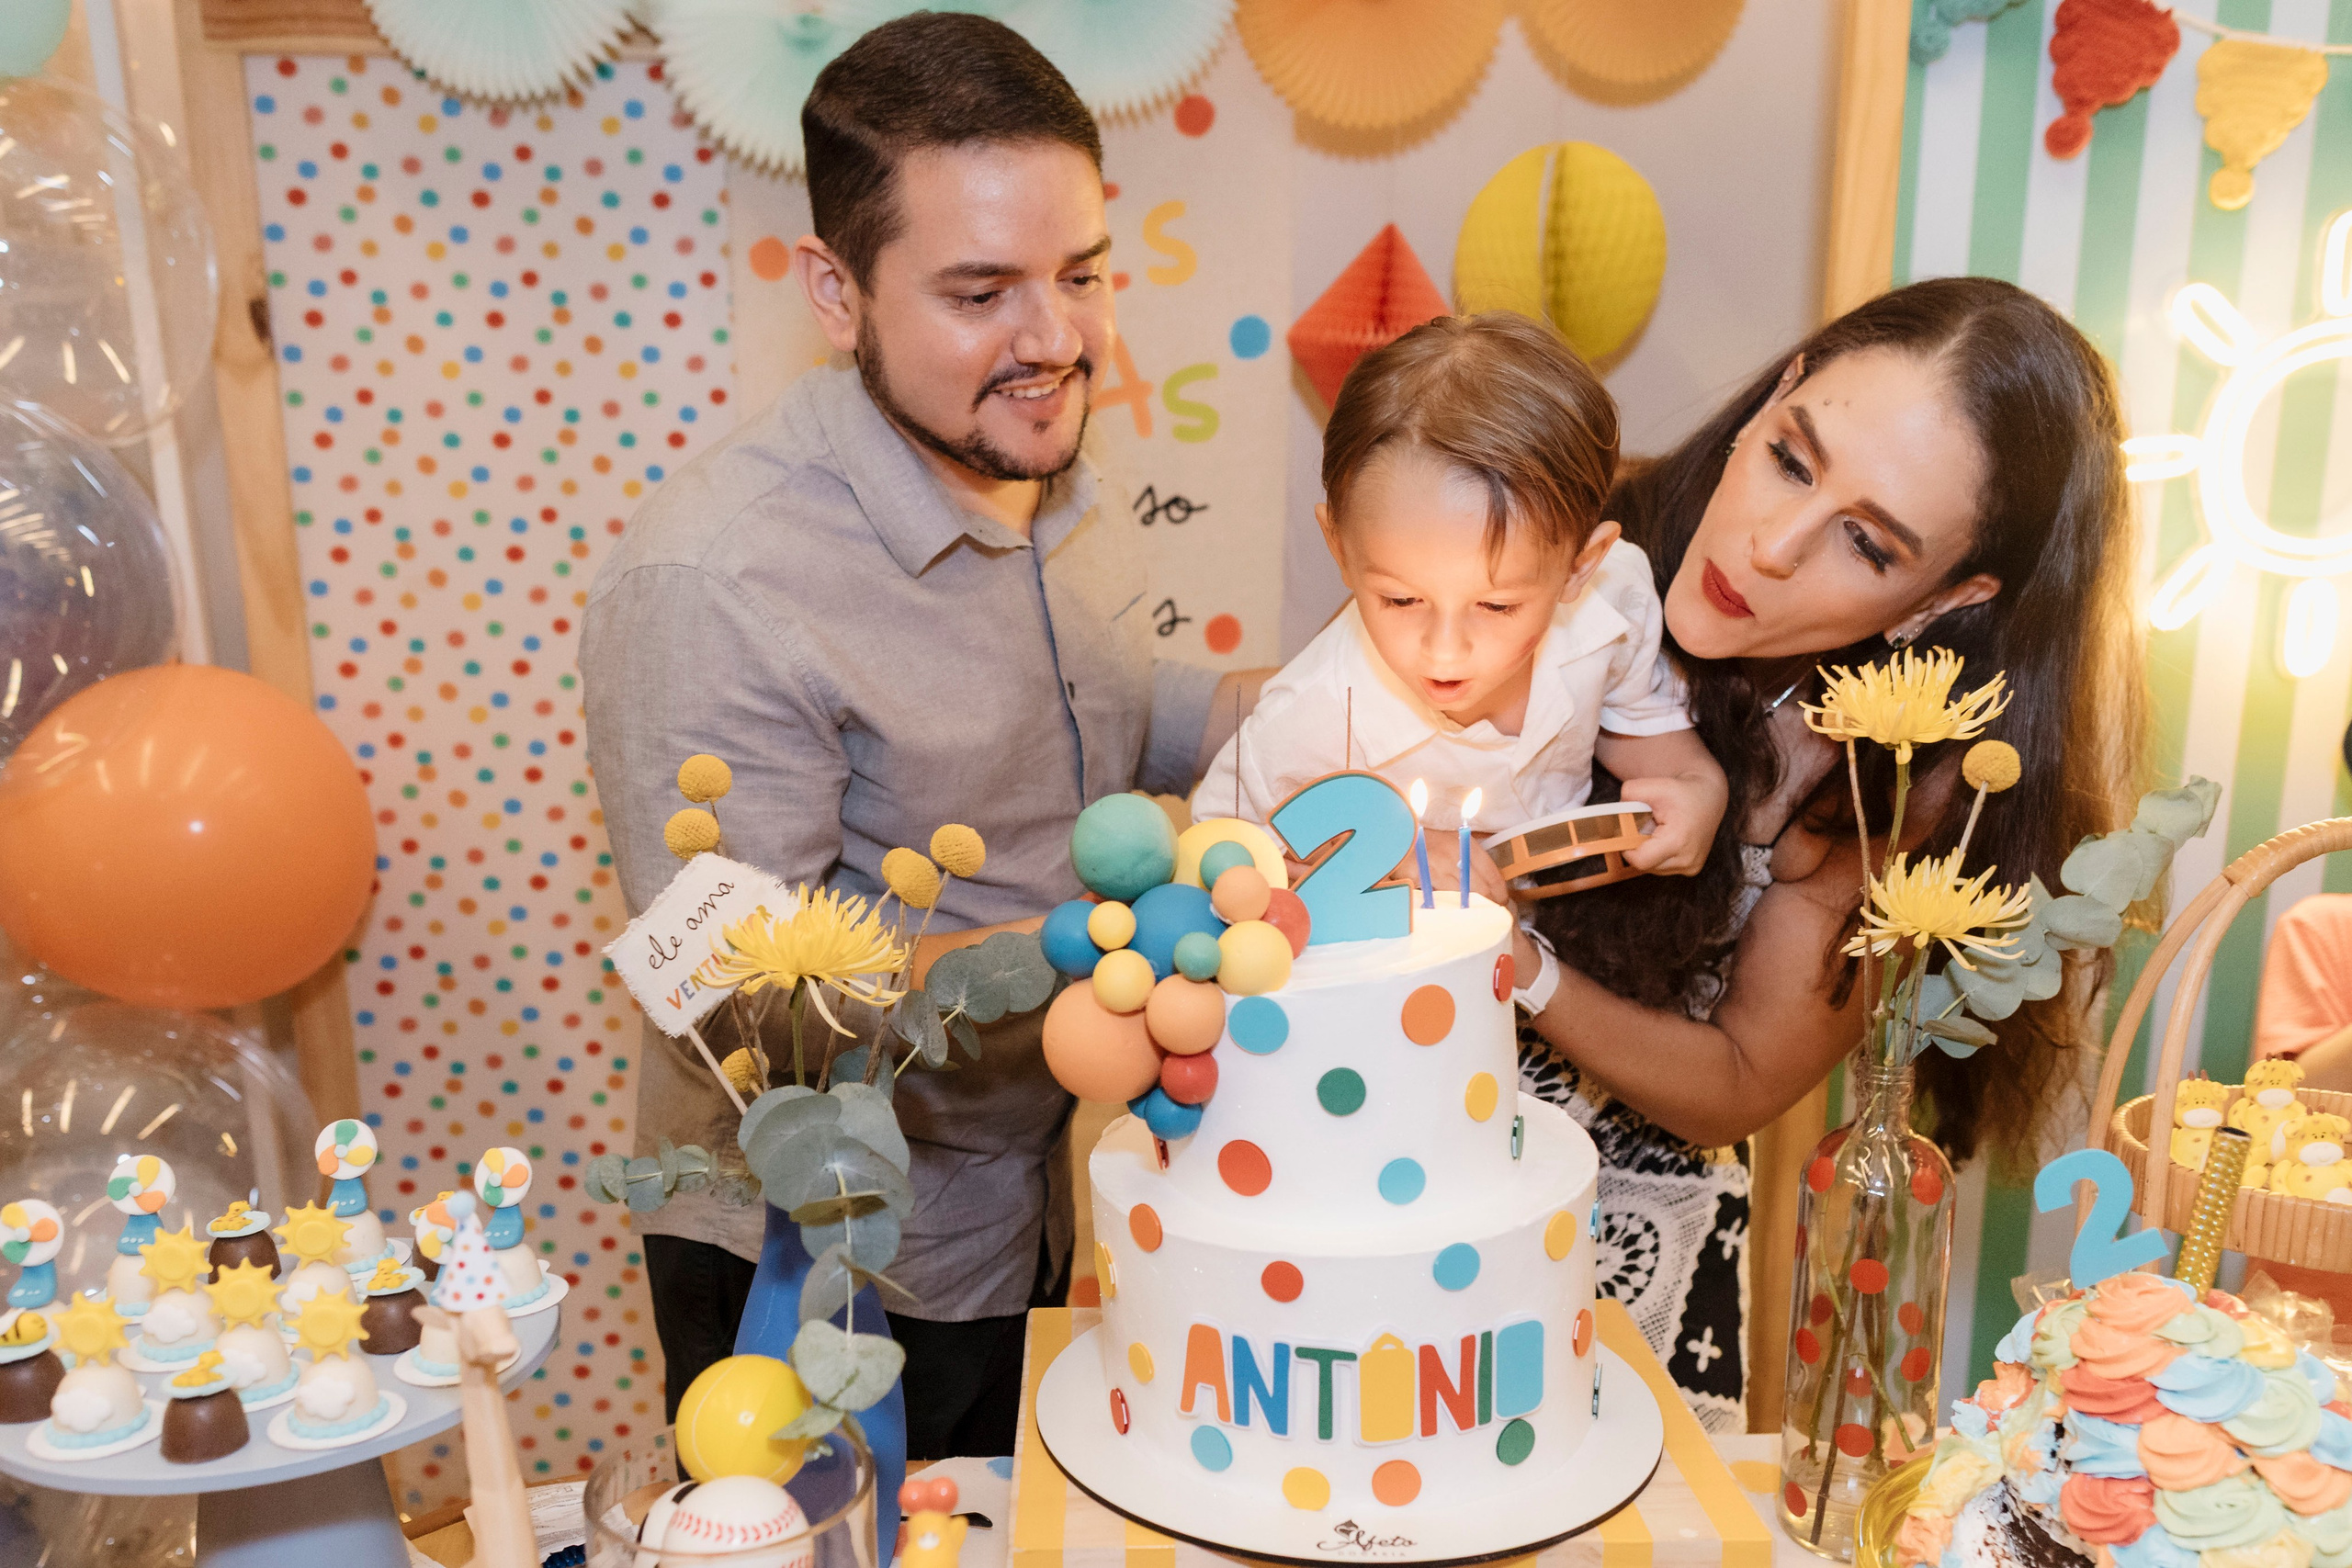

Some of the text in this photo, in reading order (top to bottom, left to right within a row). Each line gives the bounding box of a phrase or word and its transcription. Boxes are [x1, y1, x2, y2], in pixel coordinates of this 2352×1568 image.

[648, 882, 735, 970] ele ama
[1267, 770, 1416, 946] 2
[2033, 1148, 2170, 1290] 2
